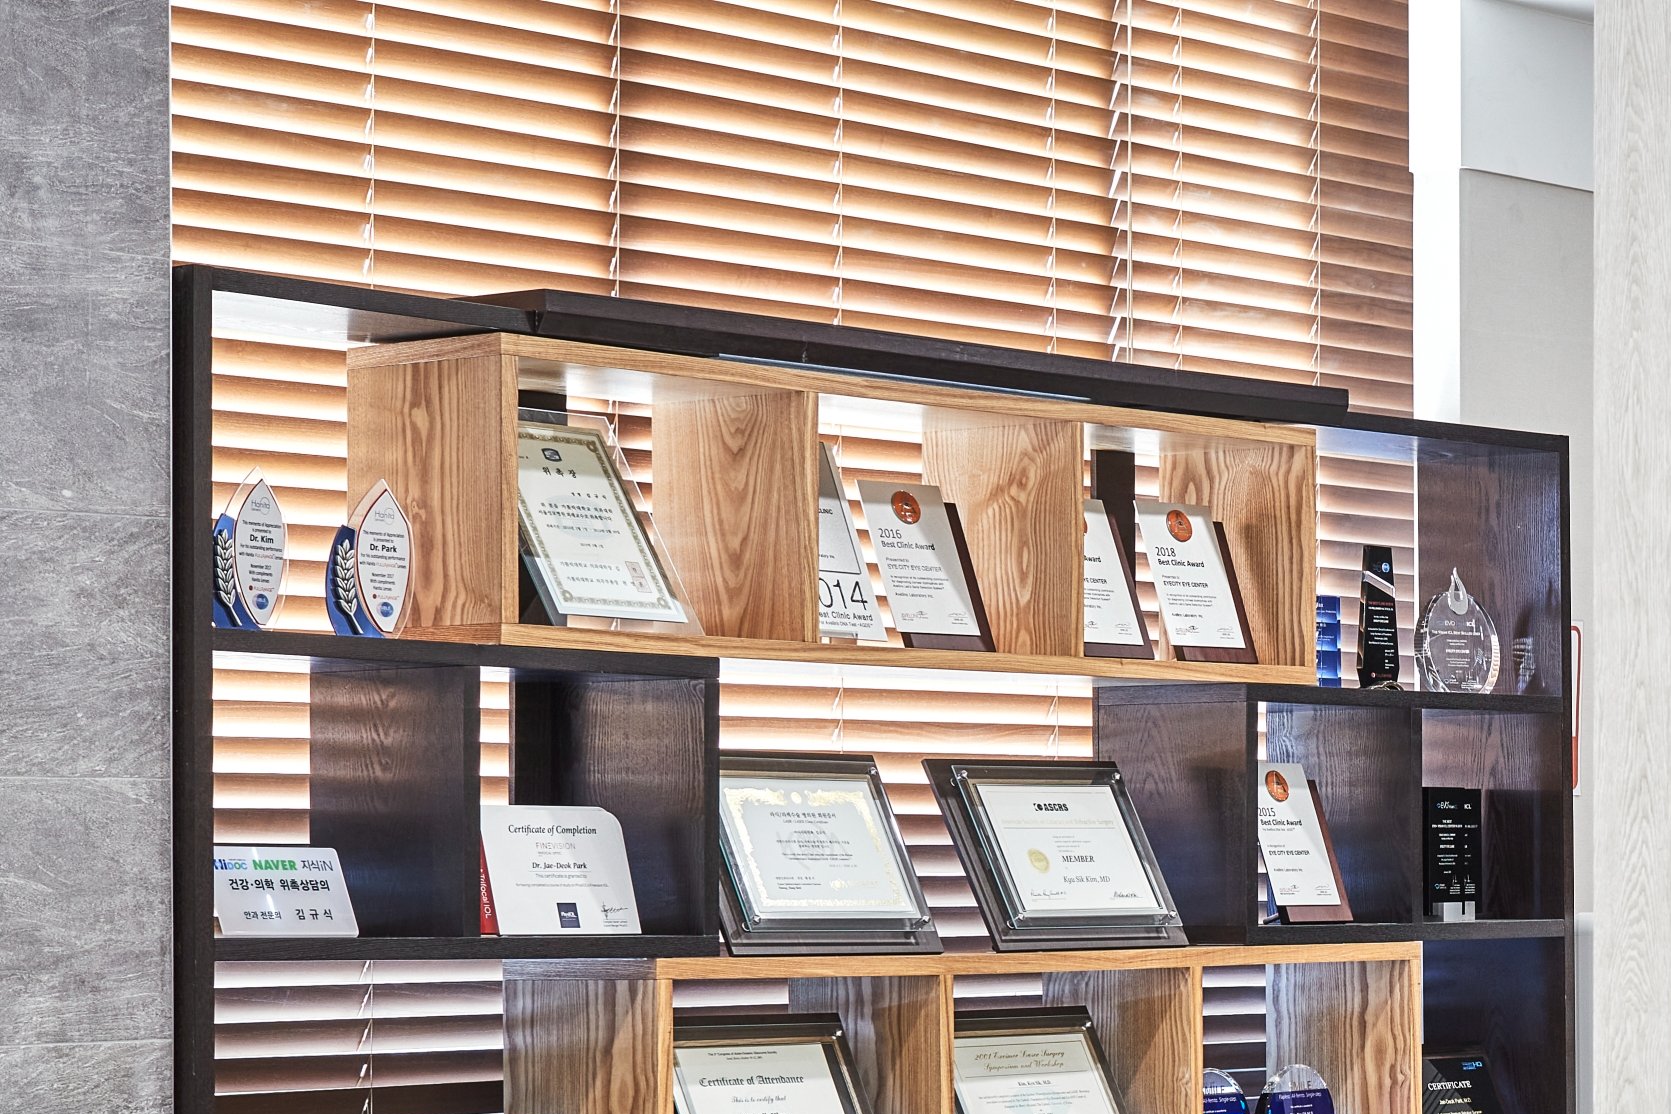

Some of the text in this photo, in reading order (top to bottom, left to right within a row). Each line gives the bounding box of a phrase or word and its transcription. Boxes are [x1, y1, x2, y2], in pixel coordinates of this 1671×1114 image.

[250, 534, 259, 542] Dr.
[878, 528, 901, 539] 2016
[915, 543, 935, 551] Award
[1155, 547, 1176, 557] 2018
[832, 612, 873, 621] Clinic Award
[1043, 803, 1069, 812] ASCRS
[1258, 807, 1275, 817] 2015
[508, 825, 597, 836] Certificate of Completion
[1062, 855, 1095, 863] MEMBER
[252, 860, 298, 871] NAVER
[301, 860, 333, 871] 지식iN
[1063, 876, 1075, 884] Kyu
[229, 879, 330, 891] 건강·의학 위촉상담의
[244, 911, 258, 920] 안과
[261, 911, 281, 920] 전문의
[484, 905, 492, 918] IOL
[1041, 1050, 1064, 1059] Surgery
[984, 1063, 1019, 1072] Symposium
[1033, 1061, 1064, 1069] Workshop
[700, 1075, 804, 1087] Certificate of Attendance
[1428, 1081, 1472, 1090] CERTIFICATE
[757, 1096, 774, 1104] certify
